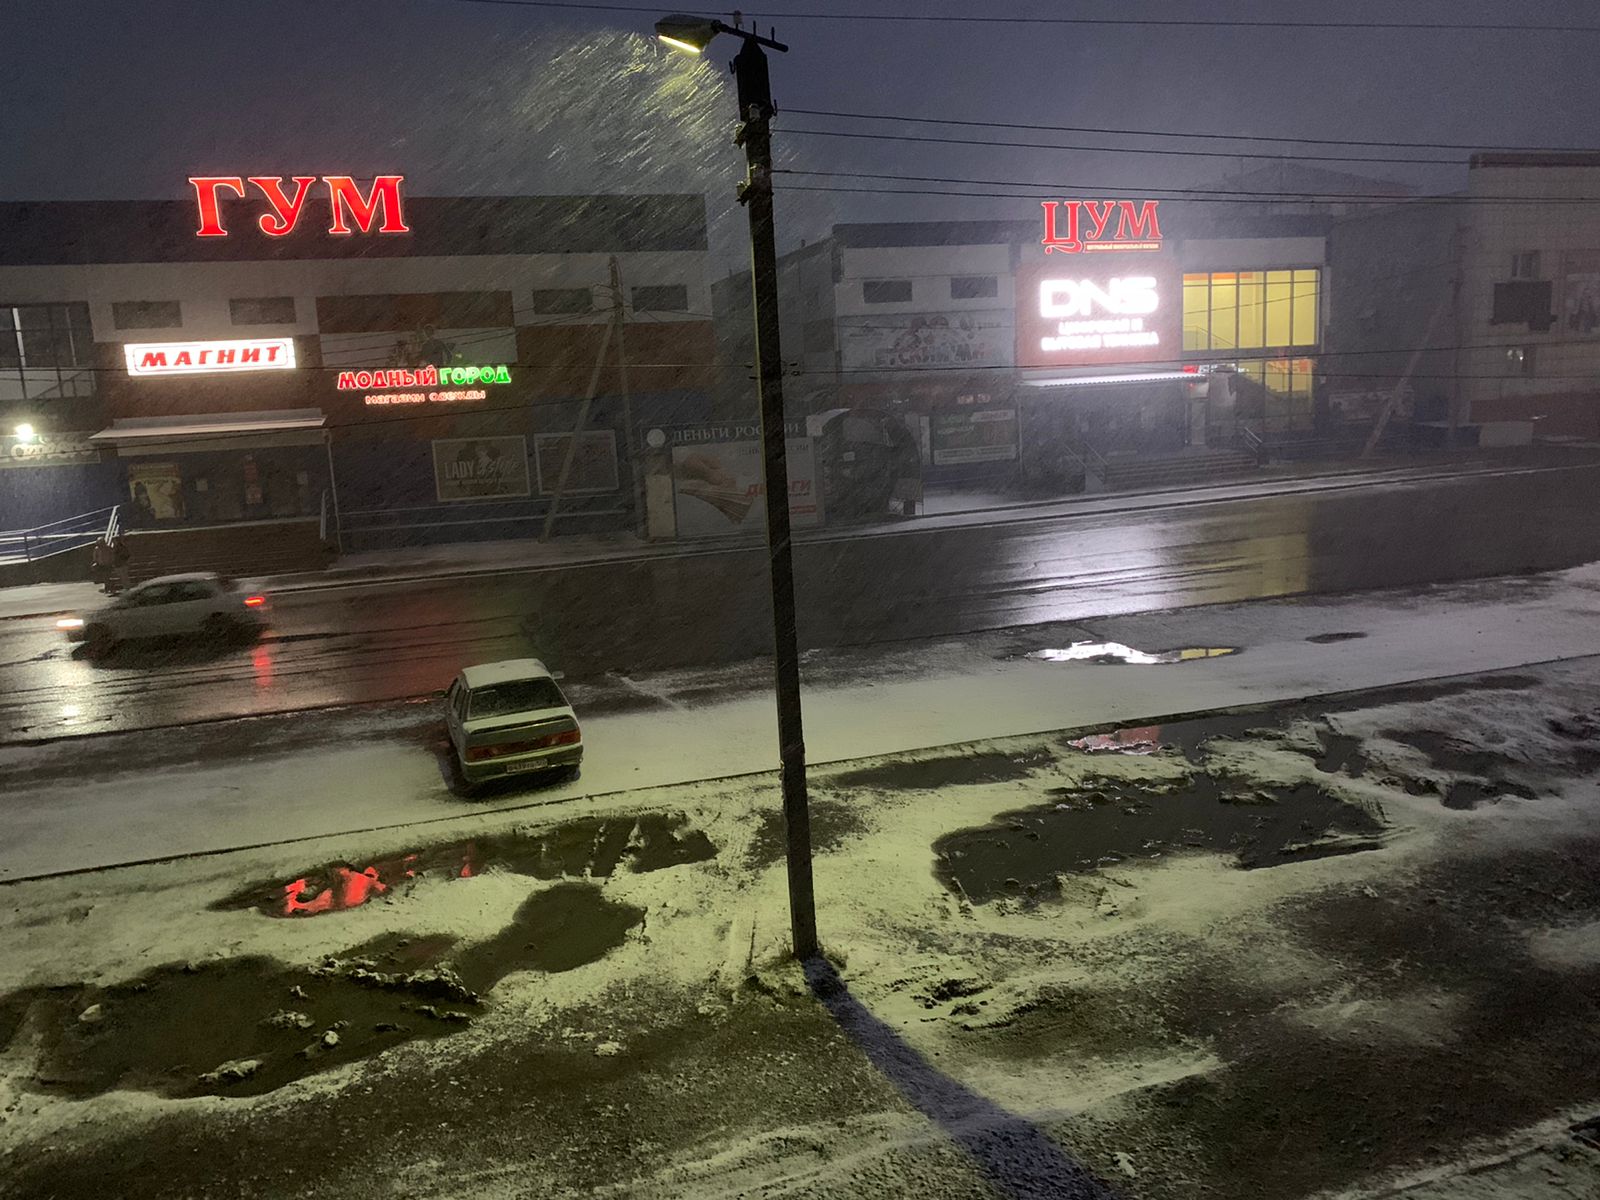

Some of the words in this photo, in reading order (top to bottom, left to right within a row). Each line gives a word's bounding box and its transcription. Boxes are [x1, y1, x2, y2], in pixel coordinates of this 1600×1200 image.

[188, 175, 410, 237] ГУМ
[1041, 200, 1164, 255] ЦУМ
[1039, 276, 1160, 318] DNS
[139, 344, 281, 369] МАГНИТ
[337, 364, 438, 390] МОДНЫЙ
[438, 365, 512, 385] ГОРОД
[444, 460, 474, 479] LADY
